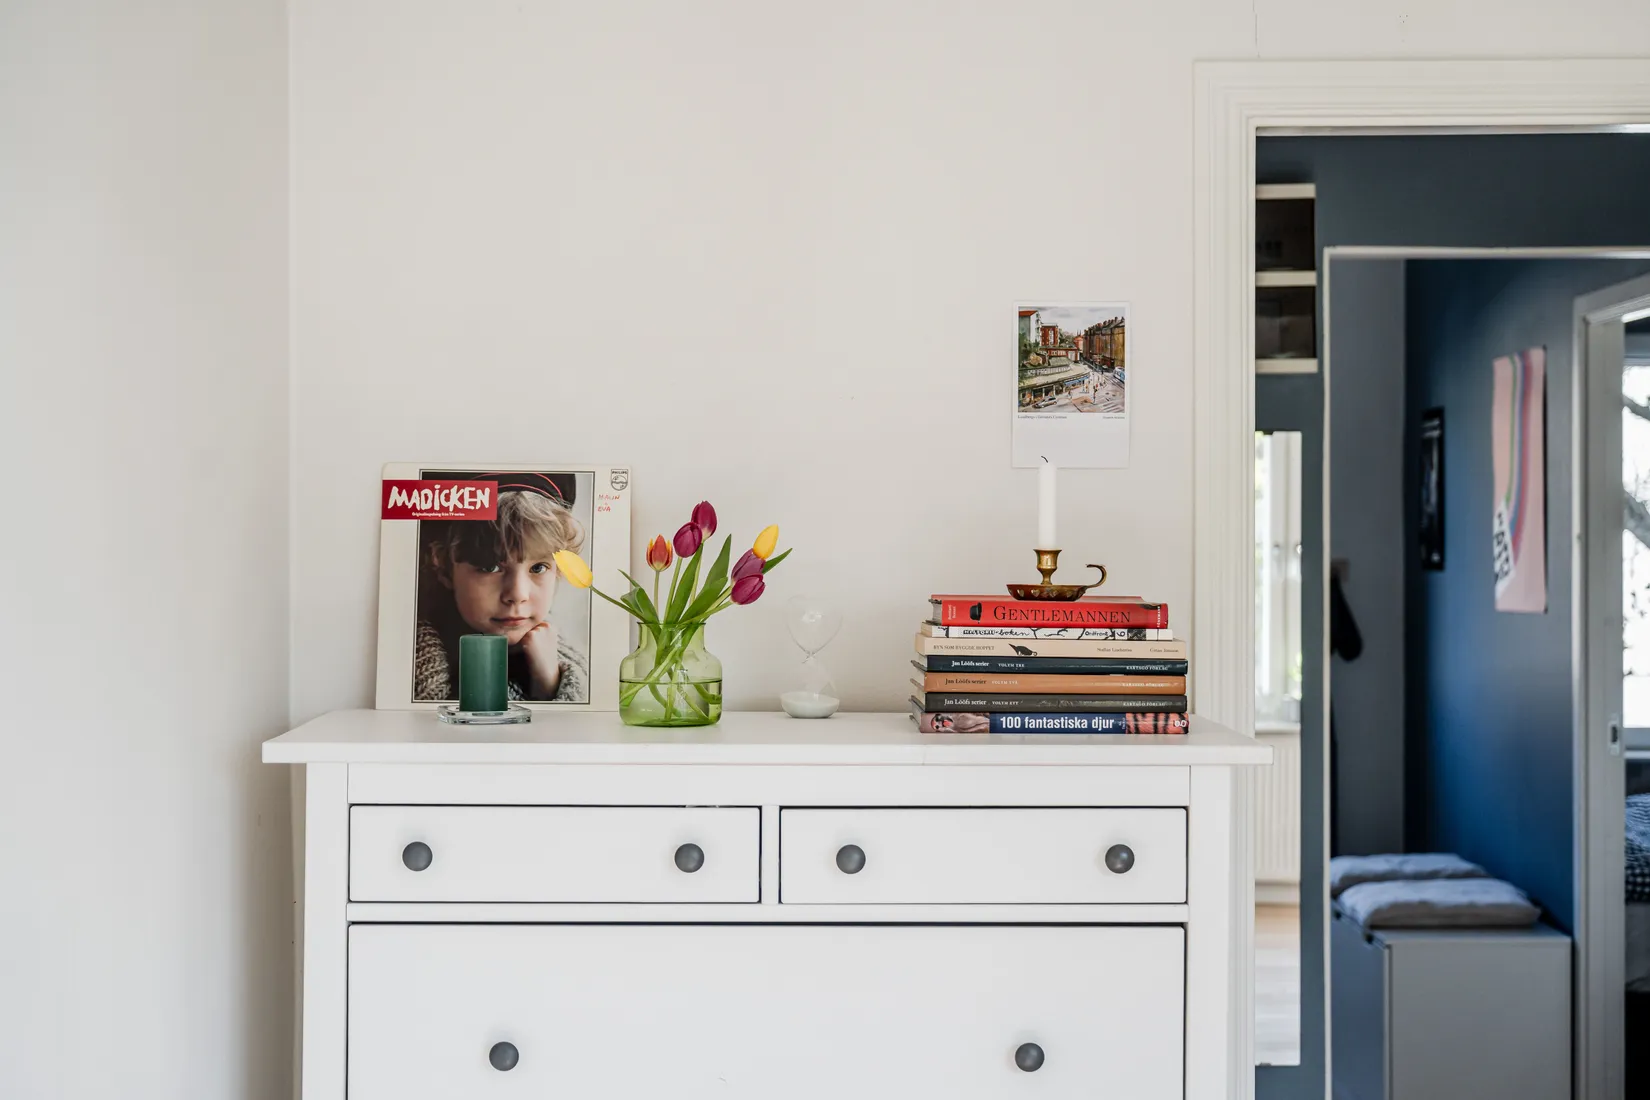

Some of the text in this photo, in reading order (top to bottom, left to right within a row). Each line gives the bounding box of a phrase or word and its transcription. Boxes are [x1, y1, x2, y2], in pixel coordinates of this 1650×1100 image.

[993, 605, 1132, 624] GENTLEMANNEN
[944, 698, 954, 706] Jan
[1000, 716, 1021, 729] 100
[1024, 716, 1088, 730] fantastiska
[1091, 716, 1115, 731] djur
